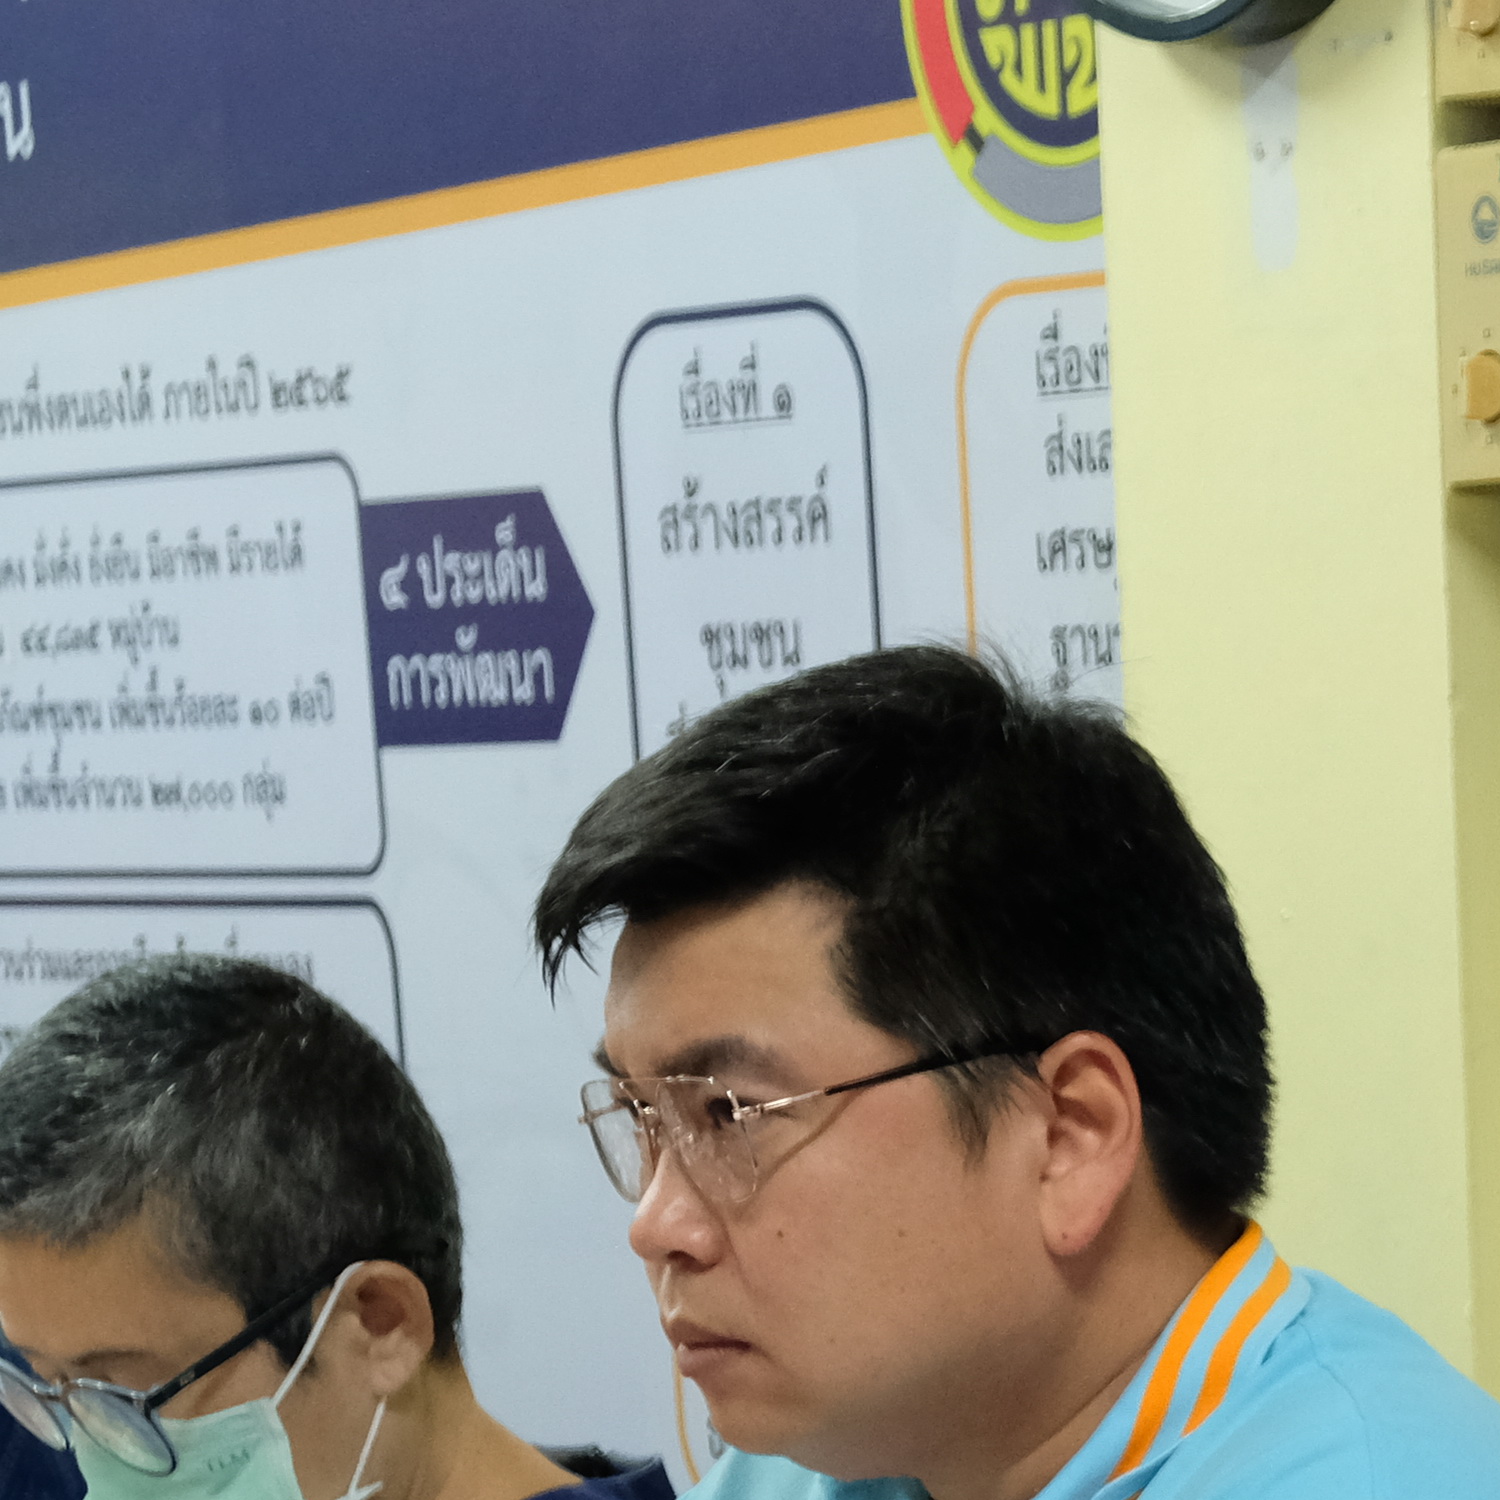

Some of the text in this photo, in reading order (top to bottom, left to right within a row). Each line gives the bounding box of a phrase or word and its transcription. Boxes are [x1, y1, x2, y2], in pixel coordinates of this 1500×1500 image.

[658, 463, 831, 554] สร้างสรรค์
[416, 512, 549, 610] ประเด็น
[386, 622, 556, 711] การพัฒนา
[699, 617, 801, 697] ชุมชน
